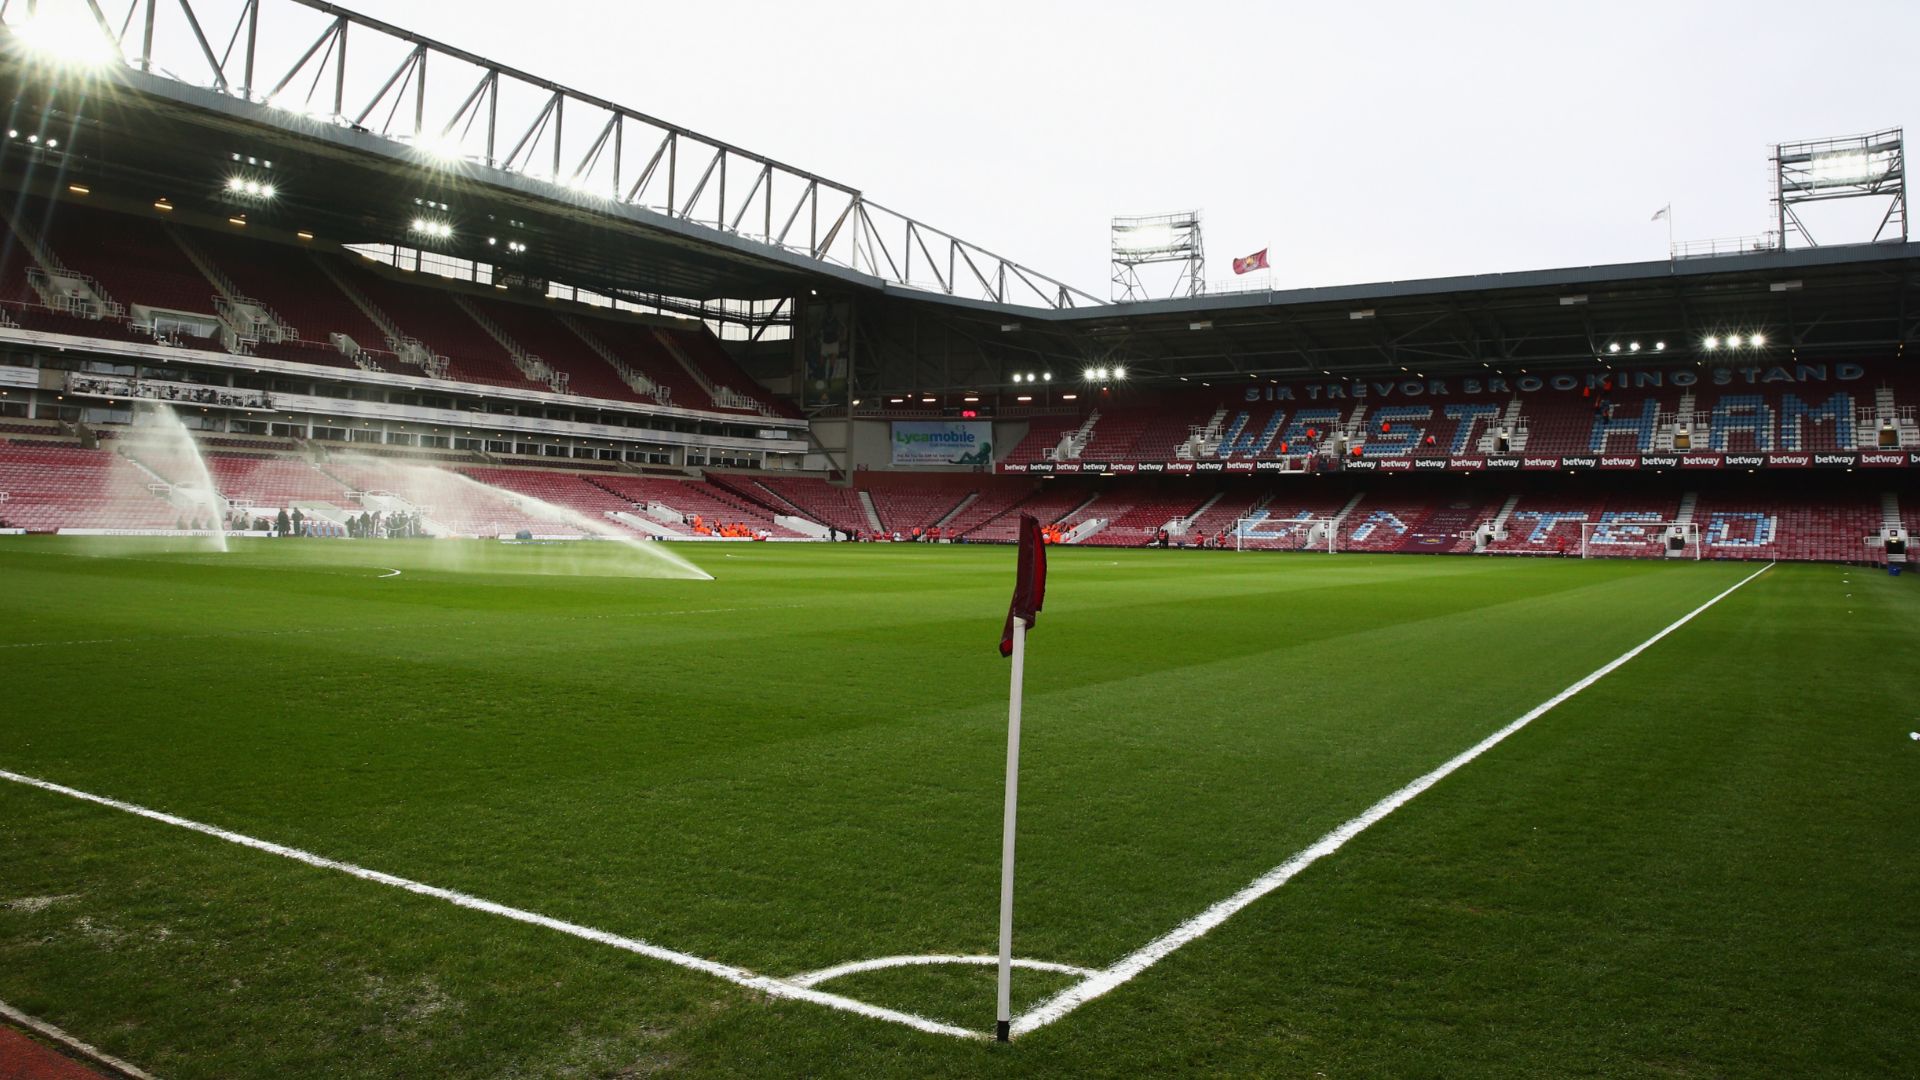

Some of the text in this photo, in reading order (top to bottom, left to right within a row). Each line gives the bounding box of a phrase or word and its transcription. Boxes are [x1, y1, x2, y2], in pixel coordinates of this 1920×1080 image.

[1245, 362, 1864, 402] SIR TREVOR BROOKING STAND
[1216, 391, 1857, 459] WEST HAM
[896, 431, 975, 444] Lycamobile
[1004, 463, 1027, 472] betway
[1029, 463, 1053, 472] betway
[1056, 463, 1079, 472] betway
[1082, 462, 1106, 472] betway
[1110, 462, 1135, 472] betway
[1138, 462, 1163, 472] betway
[1166, 462, 1192, 472] betway
[1196, 462, 1222, 471] betway
[1226, 461, 1253, 471] betway
[1380, 459, 1410, 470] betway
[1415, 459, 1446, 469] betway
[1450, 458, 1482, 469] betway
[1487, 458, 1519, 468] betway
[1524, 457, 1557, 468] betway
[1562, 457, 1596, 468] betway
[1601, 457, 1636, 468] betway
[1641, 456, 1677, 467] betway
[1683, 456, 1719, 467] betway
[1725, 455, 1763, 466] betway
[1769, 455, 1808, 466] betway
[1814, 454, 1855, 466] betway
[1861, 454, 1903, 465] betway
